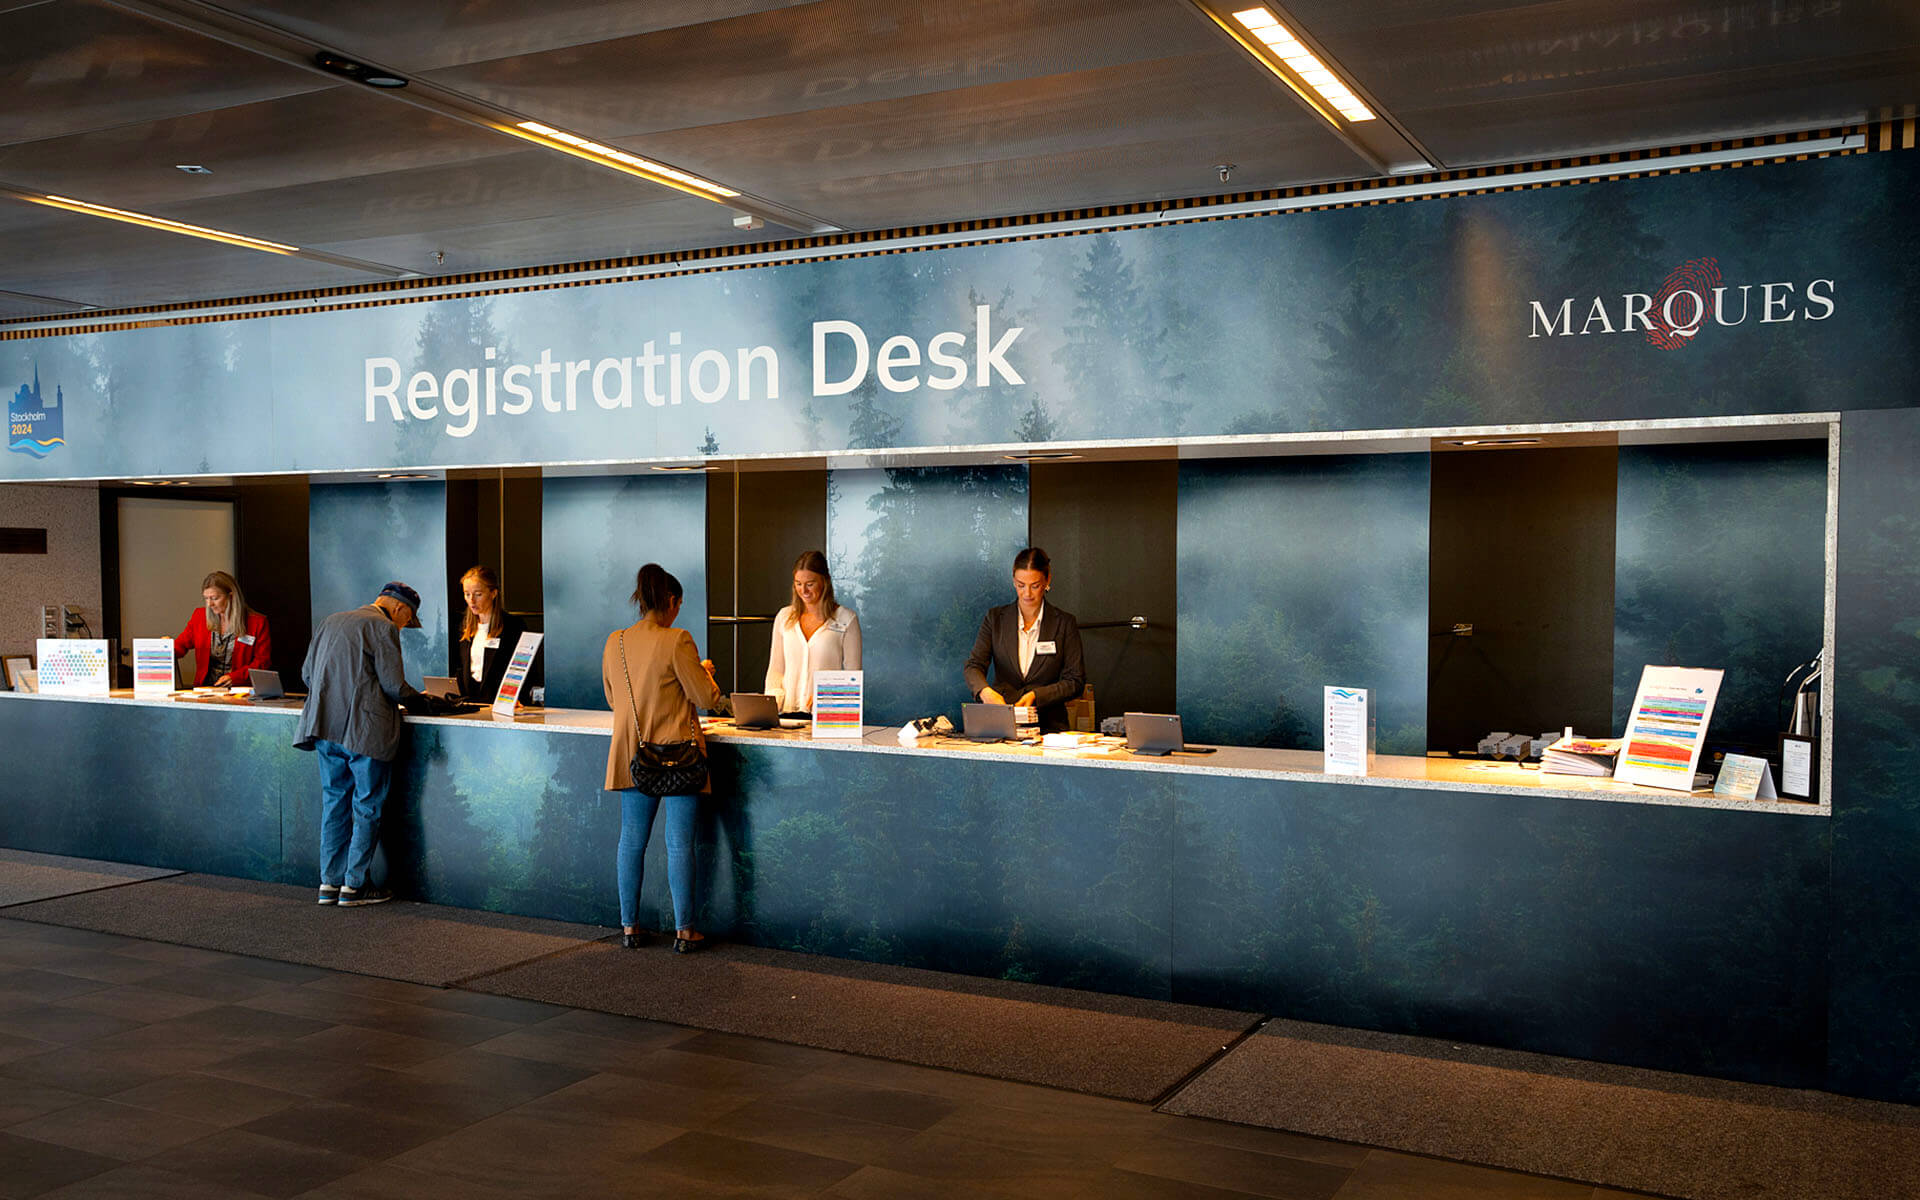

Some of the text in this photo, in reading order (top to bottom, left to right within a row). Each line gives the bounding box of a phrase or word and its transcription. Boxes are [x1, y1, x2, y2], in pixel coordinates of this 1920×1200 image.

[1527, 279, 1836, 338] MARQUES
[365, 304, 1026, 438] Registration Desk
[11, 412, 46, 422] Stockholm
[11, 424, 33, 435] 2024
